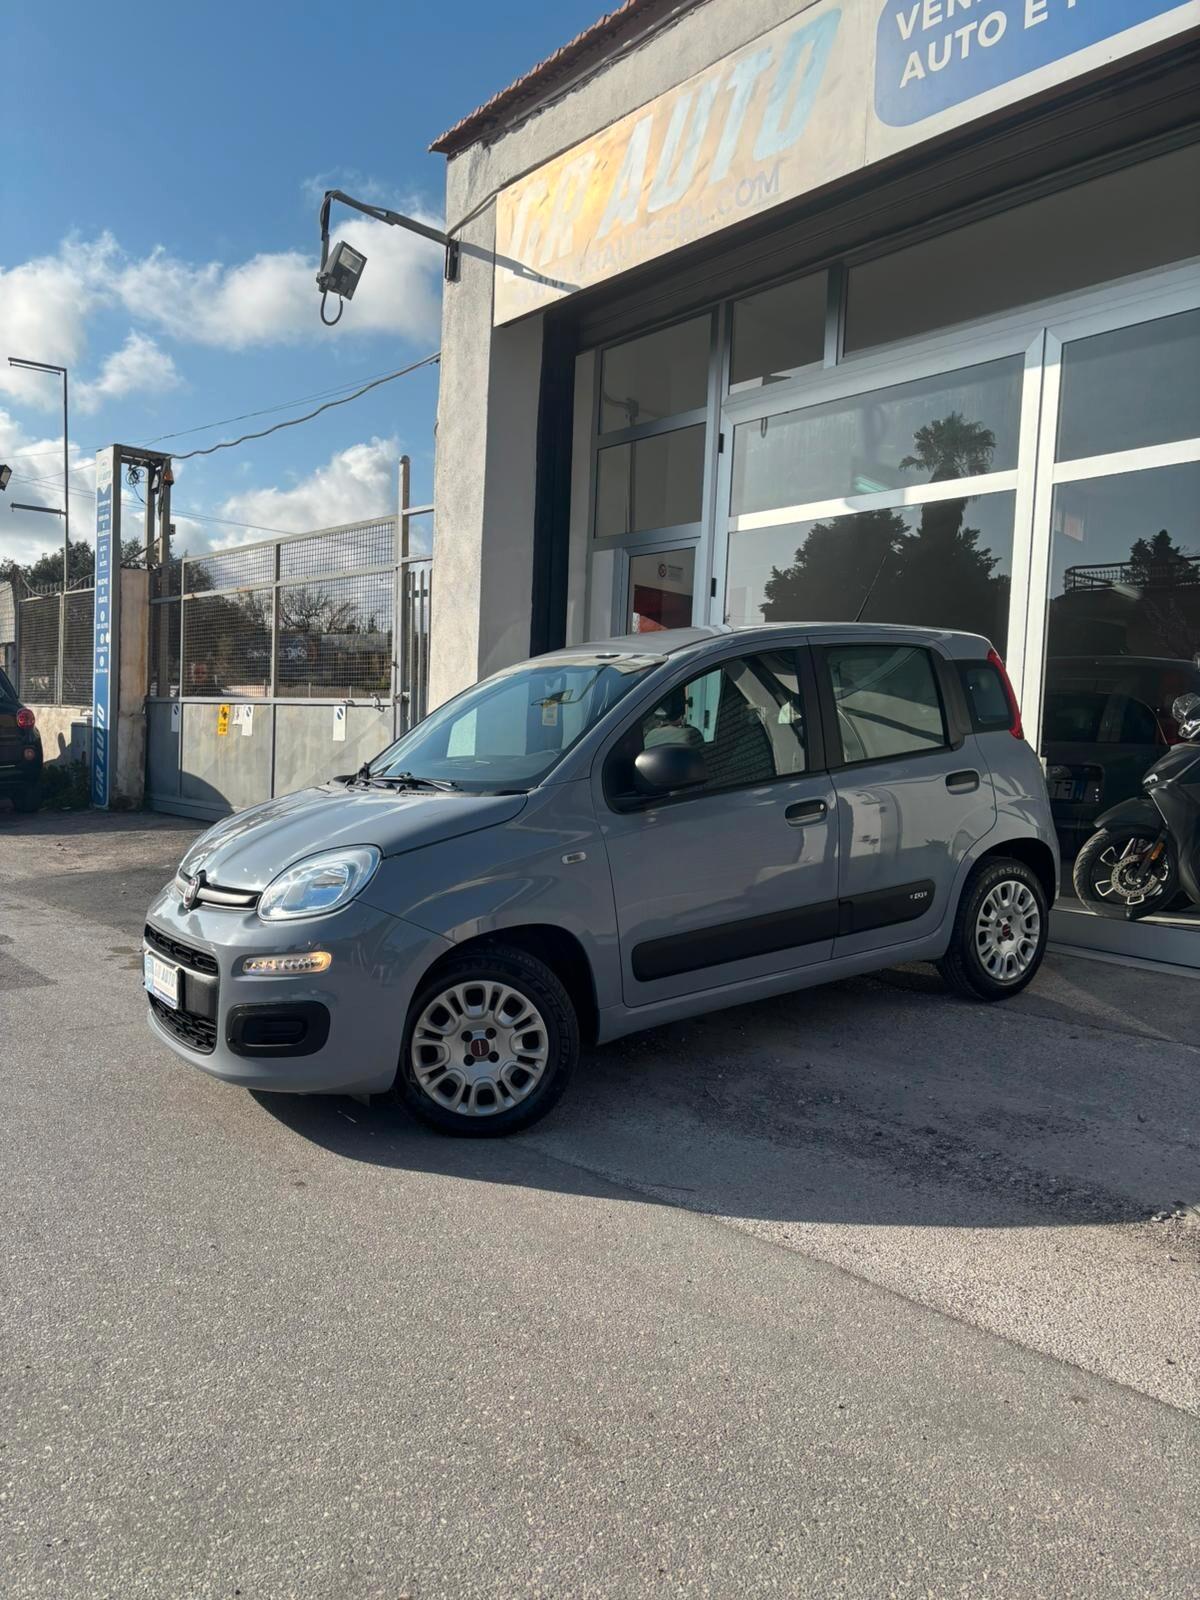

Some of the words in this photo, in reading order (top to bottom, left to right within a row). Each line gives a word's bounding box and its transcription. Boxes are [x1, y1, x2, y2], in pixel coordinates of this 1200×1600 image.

[900, 11, 1007, 88] AUTO
[1024, 0, 1048, 30] E
[596, 8, 842, 240] AUTO
[96, 703, 105, 764] AUTO
